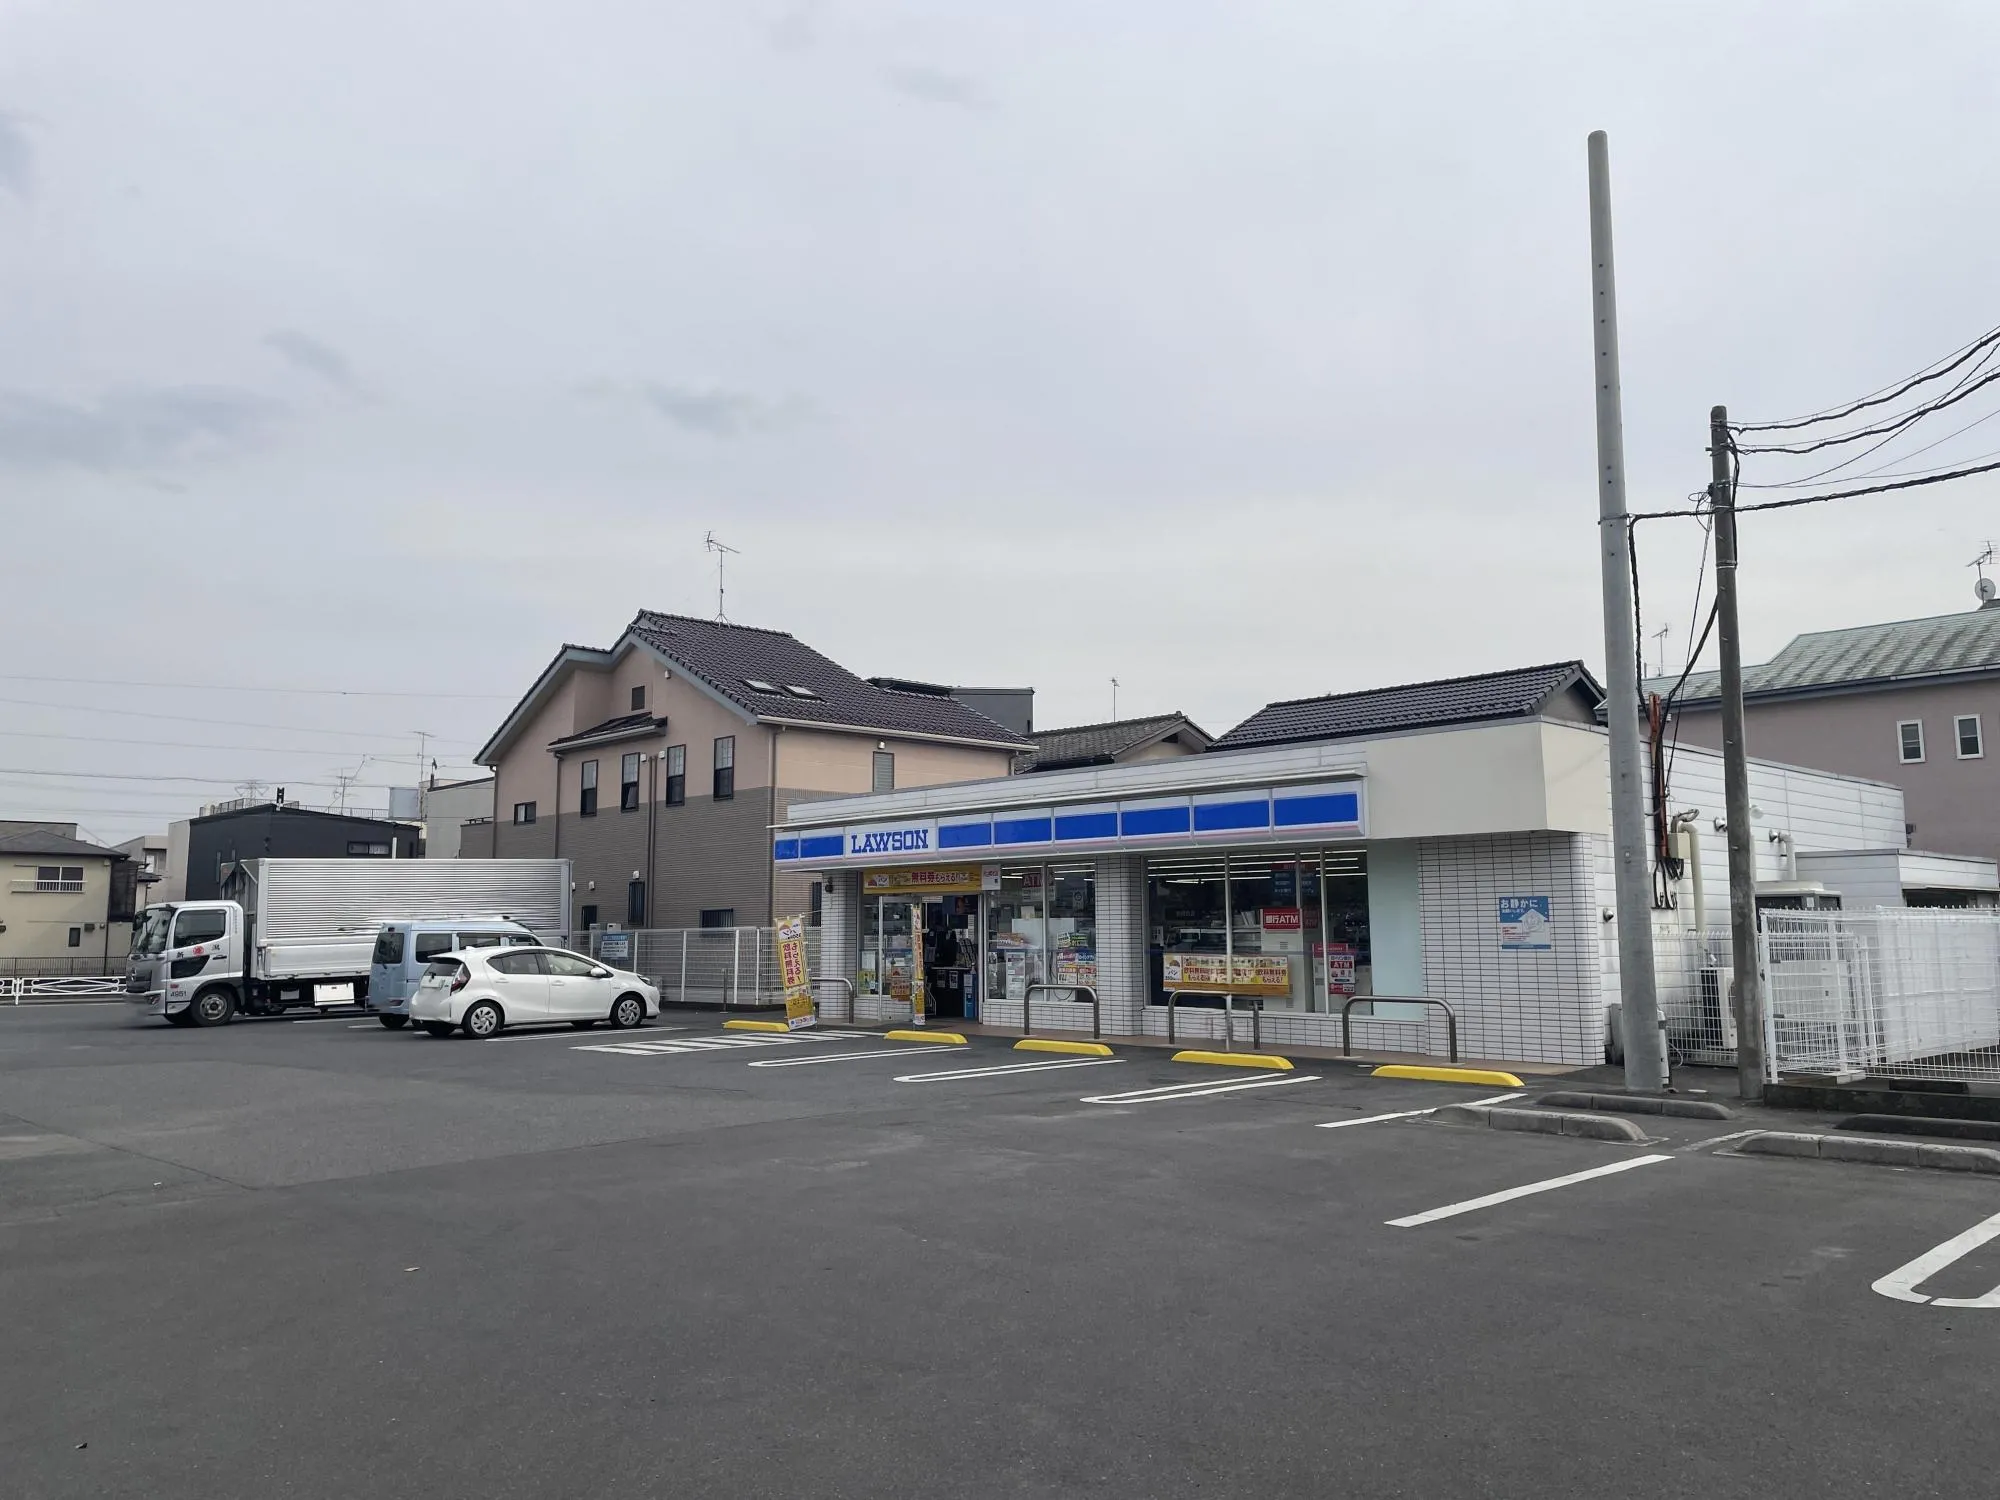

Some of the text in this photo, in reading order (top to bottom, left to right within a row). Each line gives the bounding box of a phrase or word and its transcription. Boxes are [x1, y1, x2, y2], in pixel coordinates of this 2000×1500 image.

[851, 829, 929, 854] LAWSON
[1500, 898, 1539, 909] お静かに
[1333, 961, 1351, 969] ATM
